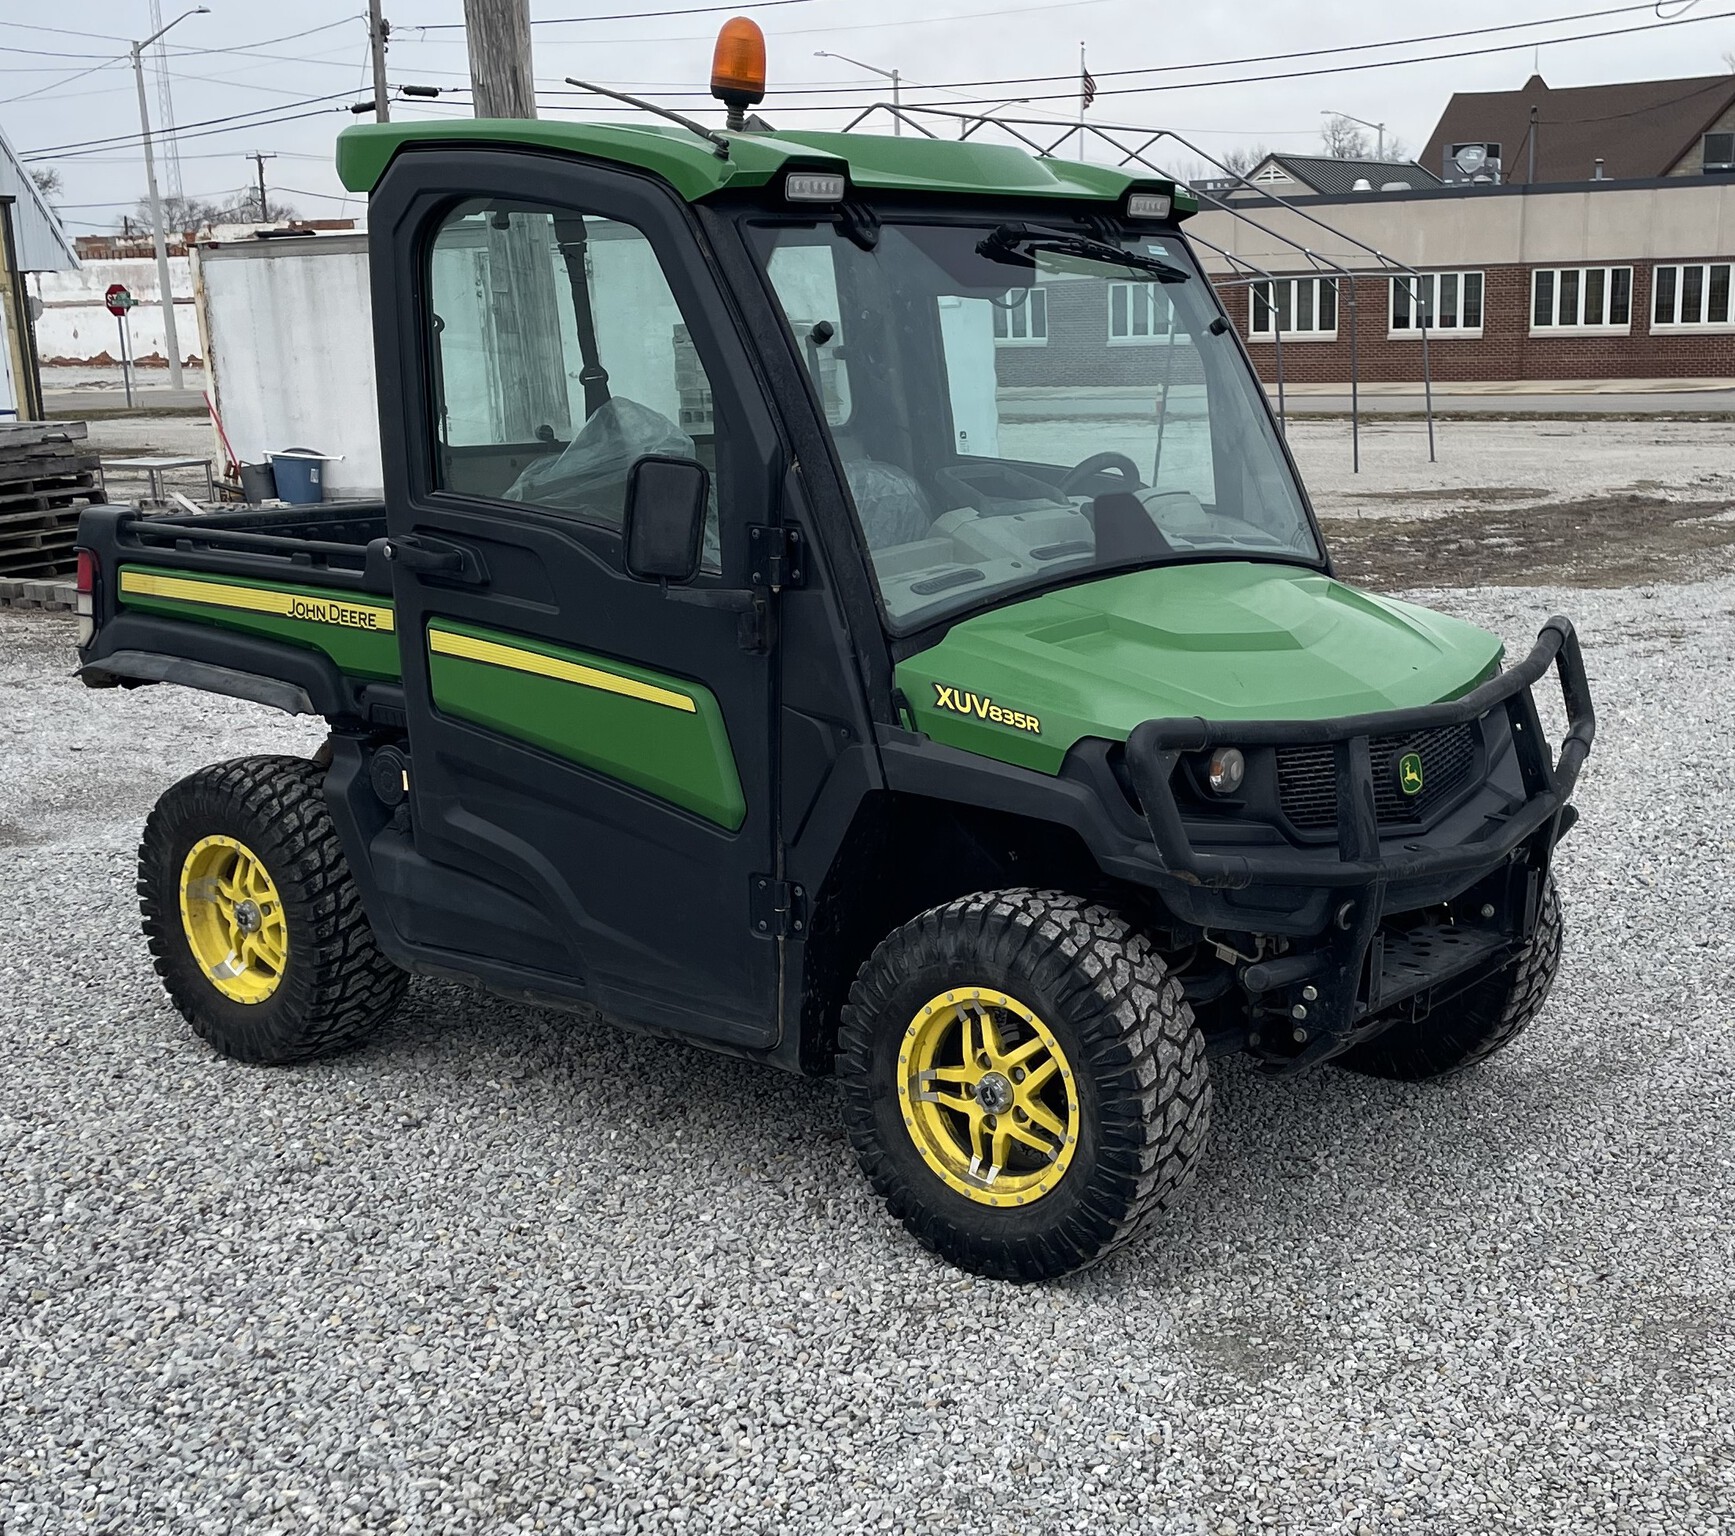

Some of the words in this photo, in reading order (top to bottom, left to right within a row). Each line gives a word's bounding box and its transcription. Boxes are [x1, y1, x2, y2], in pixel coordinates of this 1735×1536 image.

[287, 598, 326, 620] JOHN
[328, 603, 377, 628] DEERE
[933, 682, 1041, 734] XUV835R
